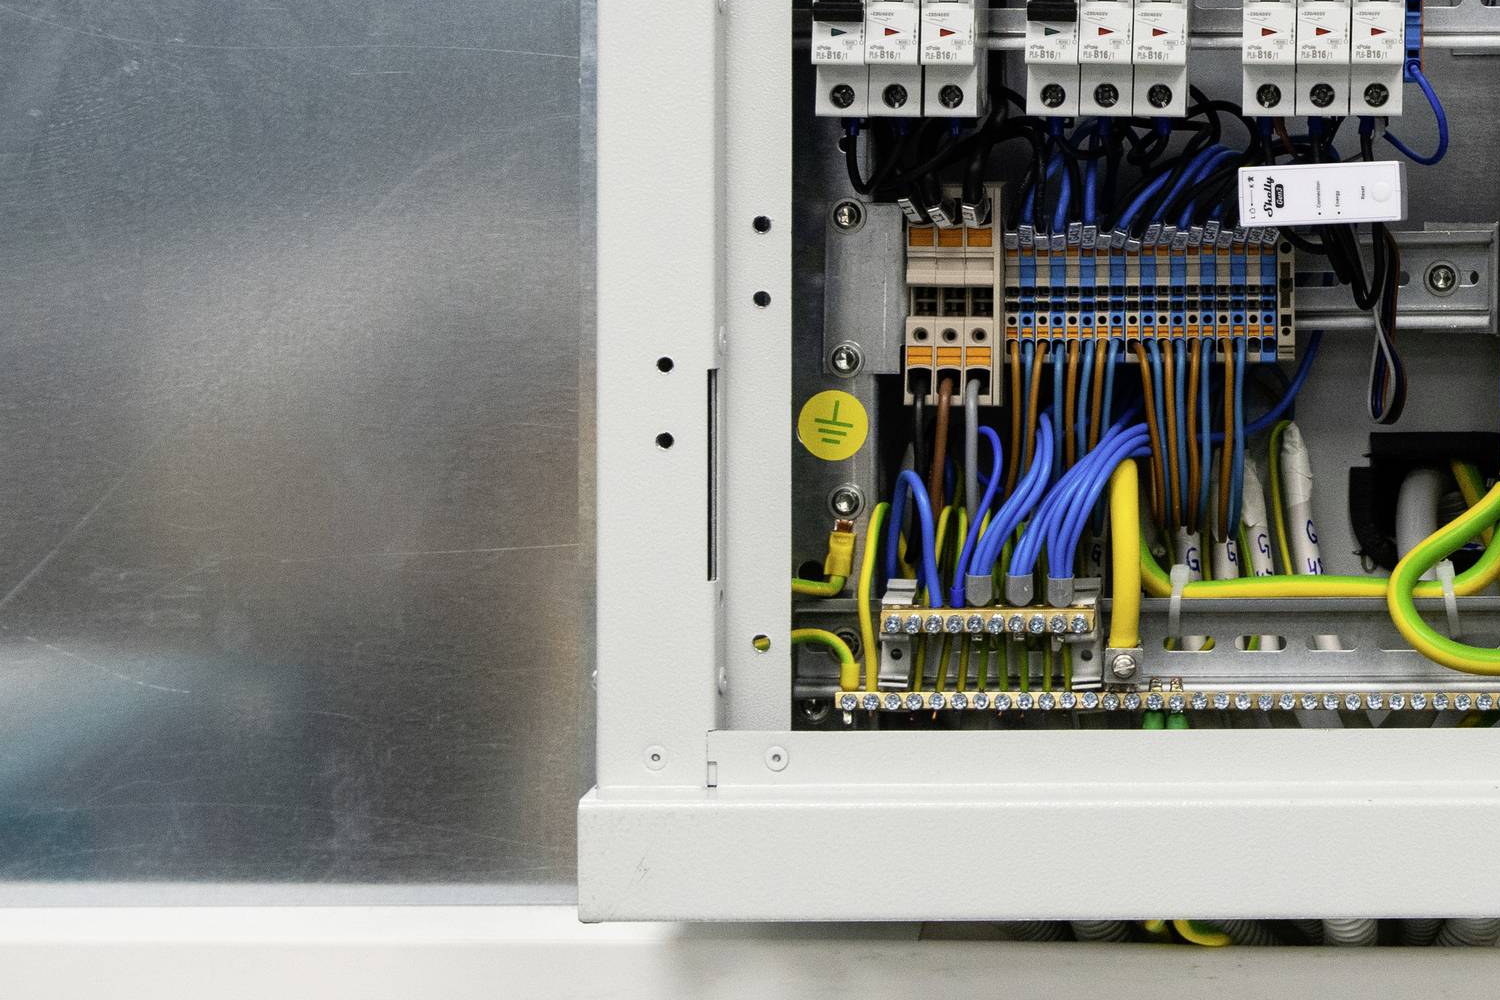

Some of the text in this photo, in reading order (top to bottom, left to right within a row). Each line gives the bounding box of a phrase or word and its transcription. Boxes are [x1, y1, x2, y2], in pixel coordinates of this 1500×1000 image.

[1263, 176, 1275, 217] Shelly
[1306, 520, 1318, 543] G
[1227, 540, 1236, 562] G
[1258, 534, 1270, 558] G
[1186, 547, 1199, 571] G
